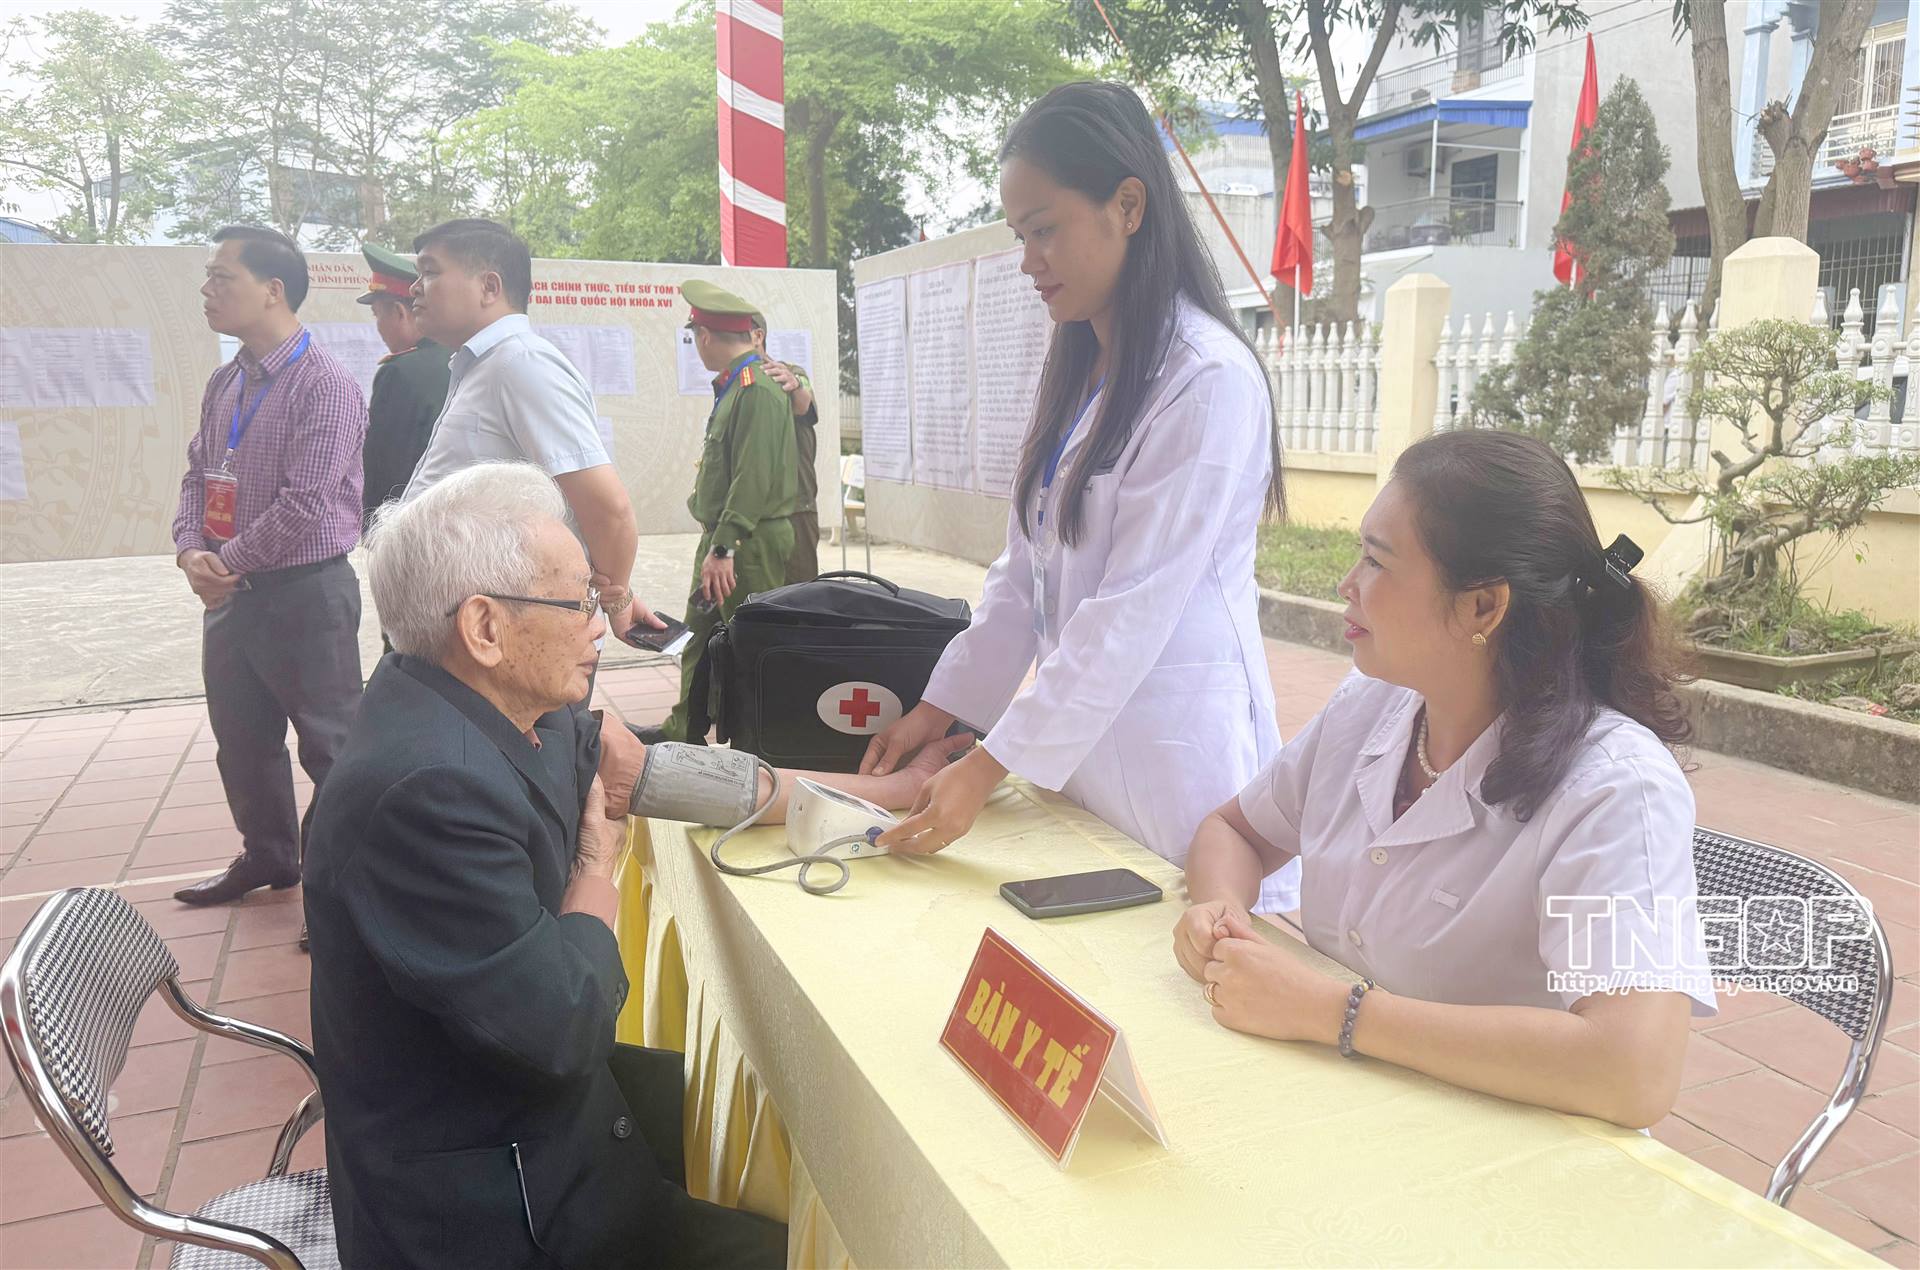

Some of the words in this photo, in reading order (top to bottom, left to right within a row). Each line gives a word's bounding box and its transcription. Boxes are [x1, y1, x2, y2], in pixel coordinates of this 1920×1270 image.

[580, 294, 607, 306] QUỐC
[657, 298, 673, 308] XVI
[965, 978, 1021, 1052] BÀN
[1012, 1018, 1043, 1070] Y
[1035, 1037, 1091, 1109] TẾ
